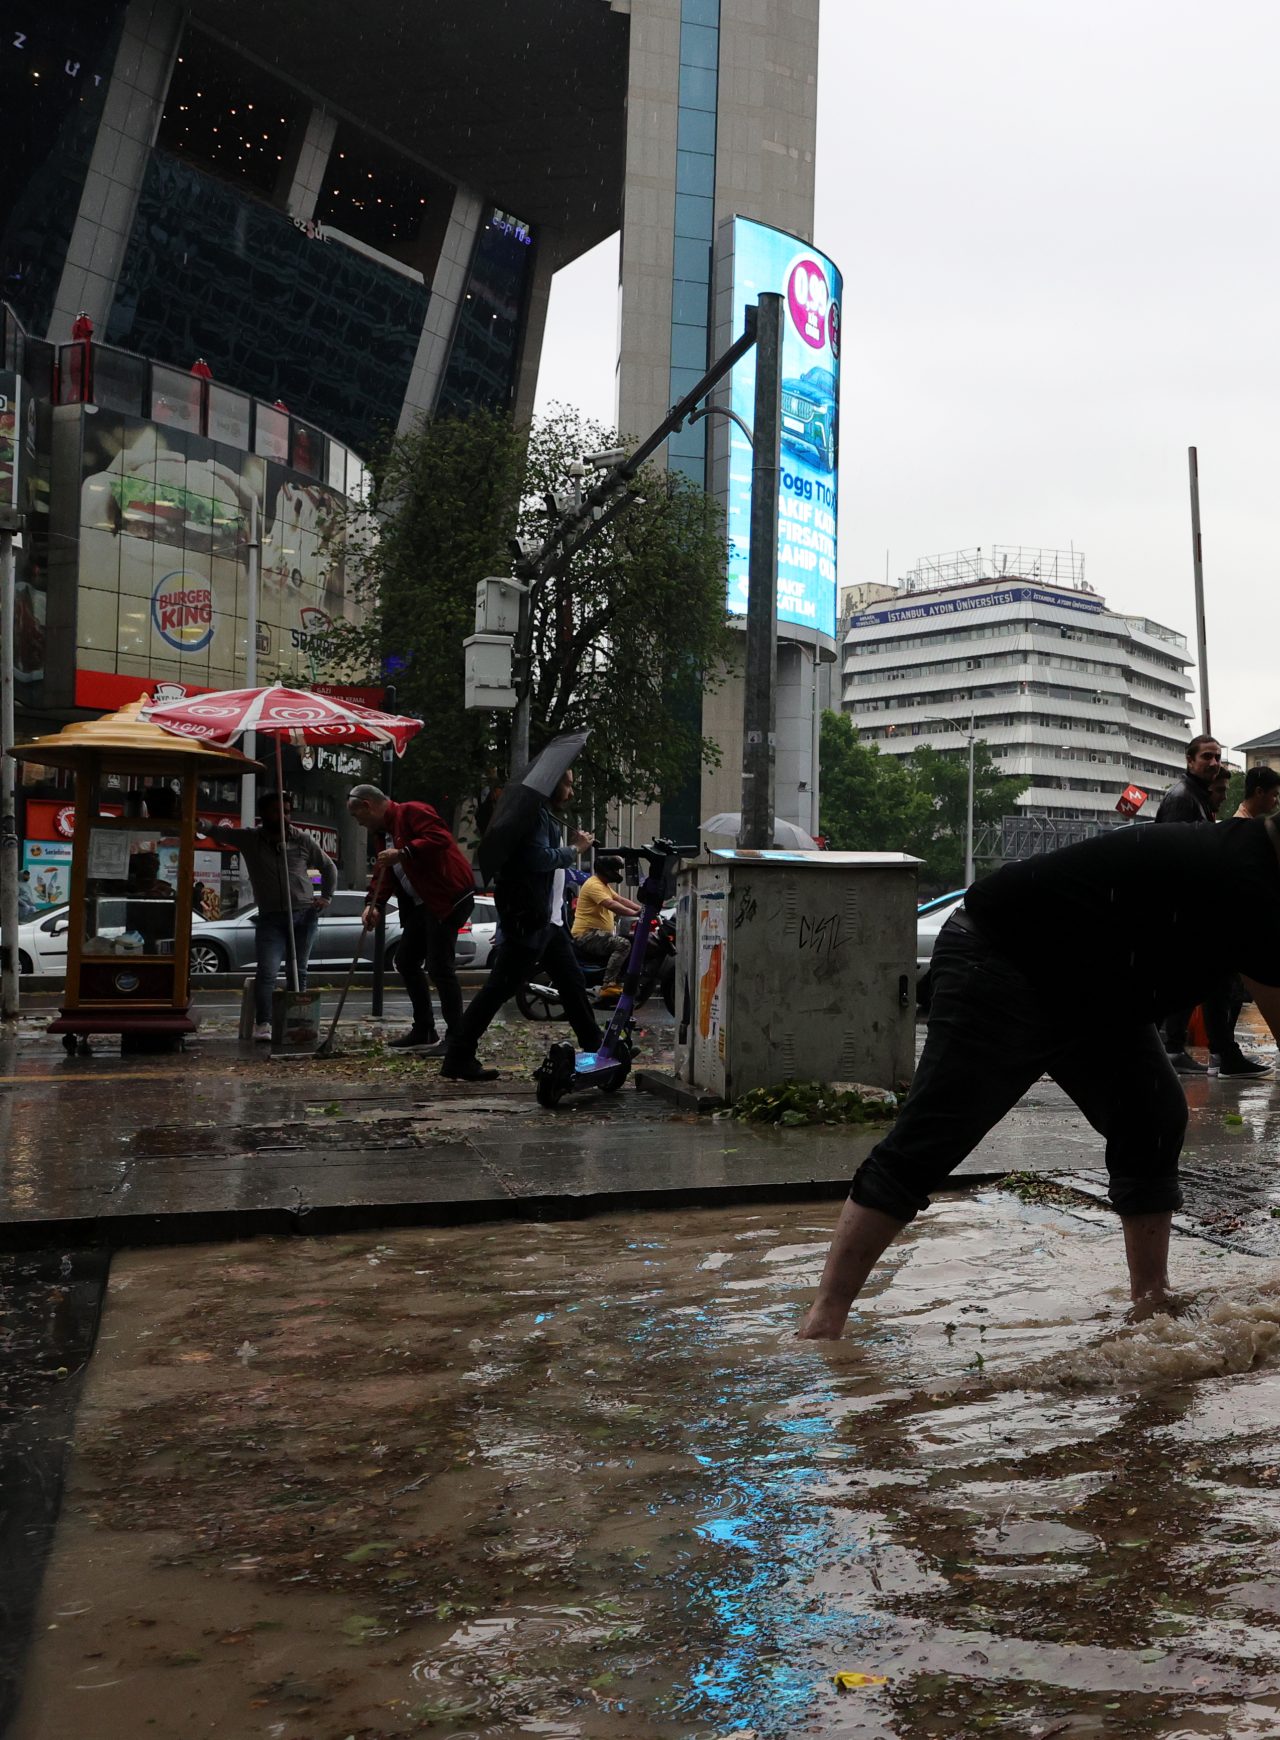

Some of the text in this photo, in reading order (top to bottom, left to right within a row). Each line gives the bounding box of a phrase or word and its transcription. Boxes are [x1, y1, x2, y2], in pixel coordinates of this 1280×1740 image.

[779, 495, 813, 523] AKIF
[159, 589, 212, 610] BURGER
[887, 590, 1014, 623] İSTANBUL AYDIN ÜNİVERSİTESİ
[161, 603, 212, 632] KING
[1128, 790, 1143, 800] M
[1120, 802, 1134, 812] M
[321, 831, 337, 854] KING
